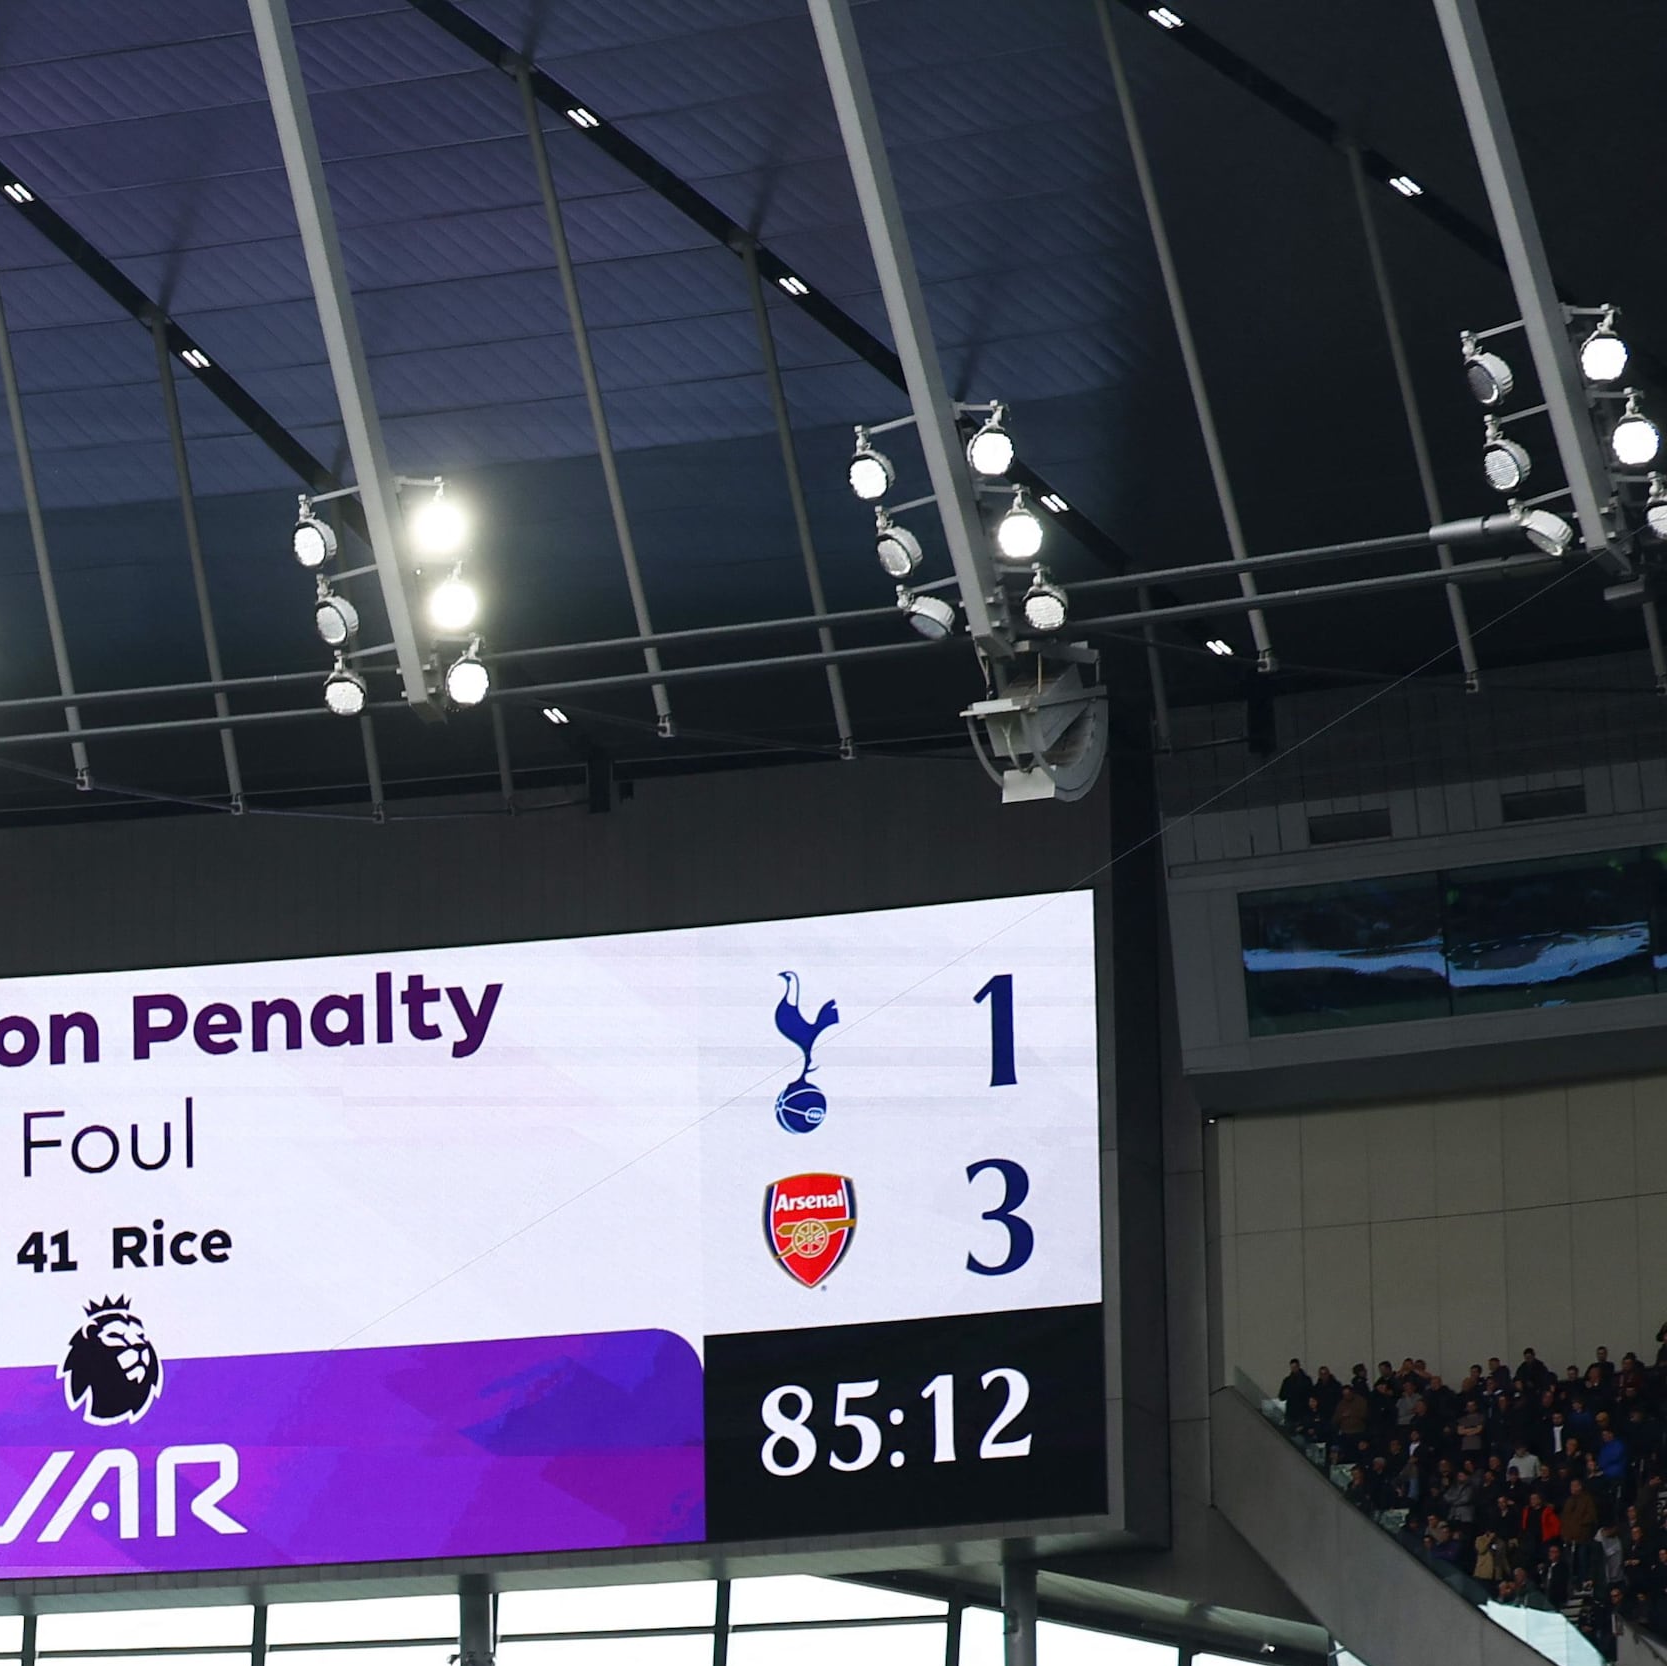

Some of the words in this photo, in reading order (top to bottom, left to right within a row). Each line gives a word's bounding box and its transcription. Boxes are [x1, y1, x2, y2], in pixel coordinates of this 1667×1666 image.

[132, 971, 504, 1060] Penalty
[973, 973, 1018, 1087] 1
[22, 1097, 194, 1177] Foul
[774, 1188, 844, 1212] Arsenal
[965, 1157, 1035, 1276] 3
[16, 1229, 78, 1273] 41
[112, 1218, 233, 1269] Rice
[760, 1367, 1033, 1477] 85:12
